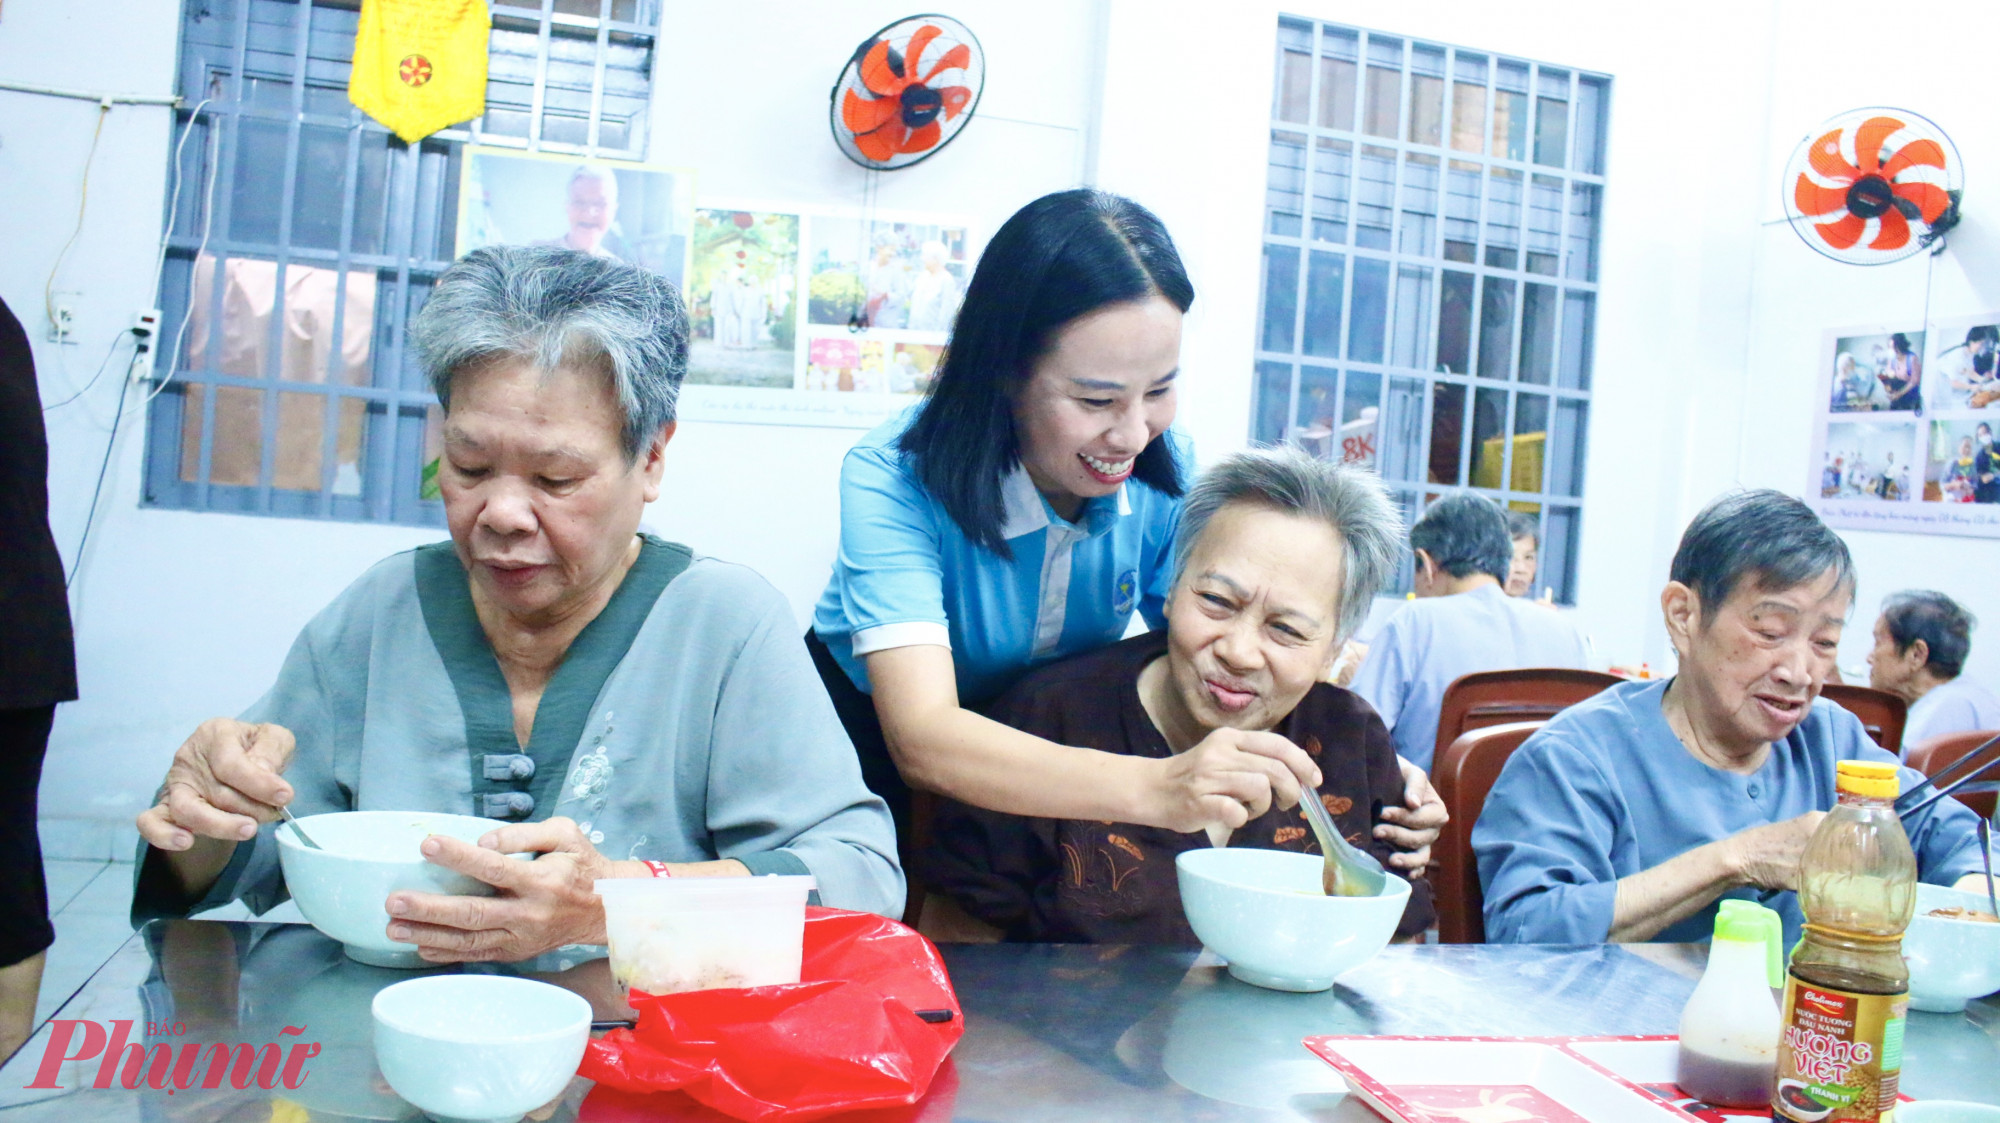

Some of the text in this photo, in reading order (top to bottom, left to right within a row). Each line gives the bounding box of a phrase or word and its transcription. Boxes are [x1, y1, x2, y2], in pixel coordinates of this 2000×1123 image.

[1804, 991, 1845, 1008] Cholimex
[1794, 1051, 1850, 1086] VIỆT
[1810, 1086, 1839, 1102] THANH
